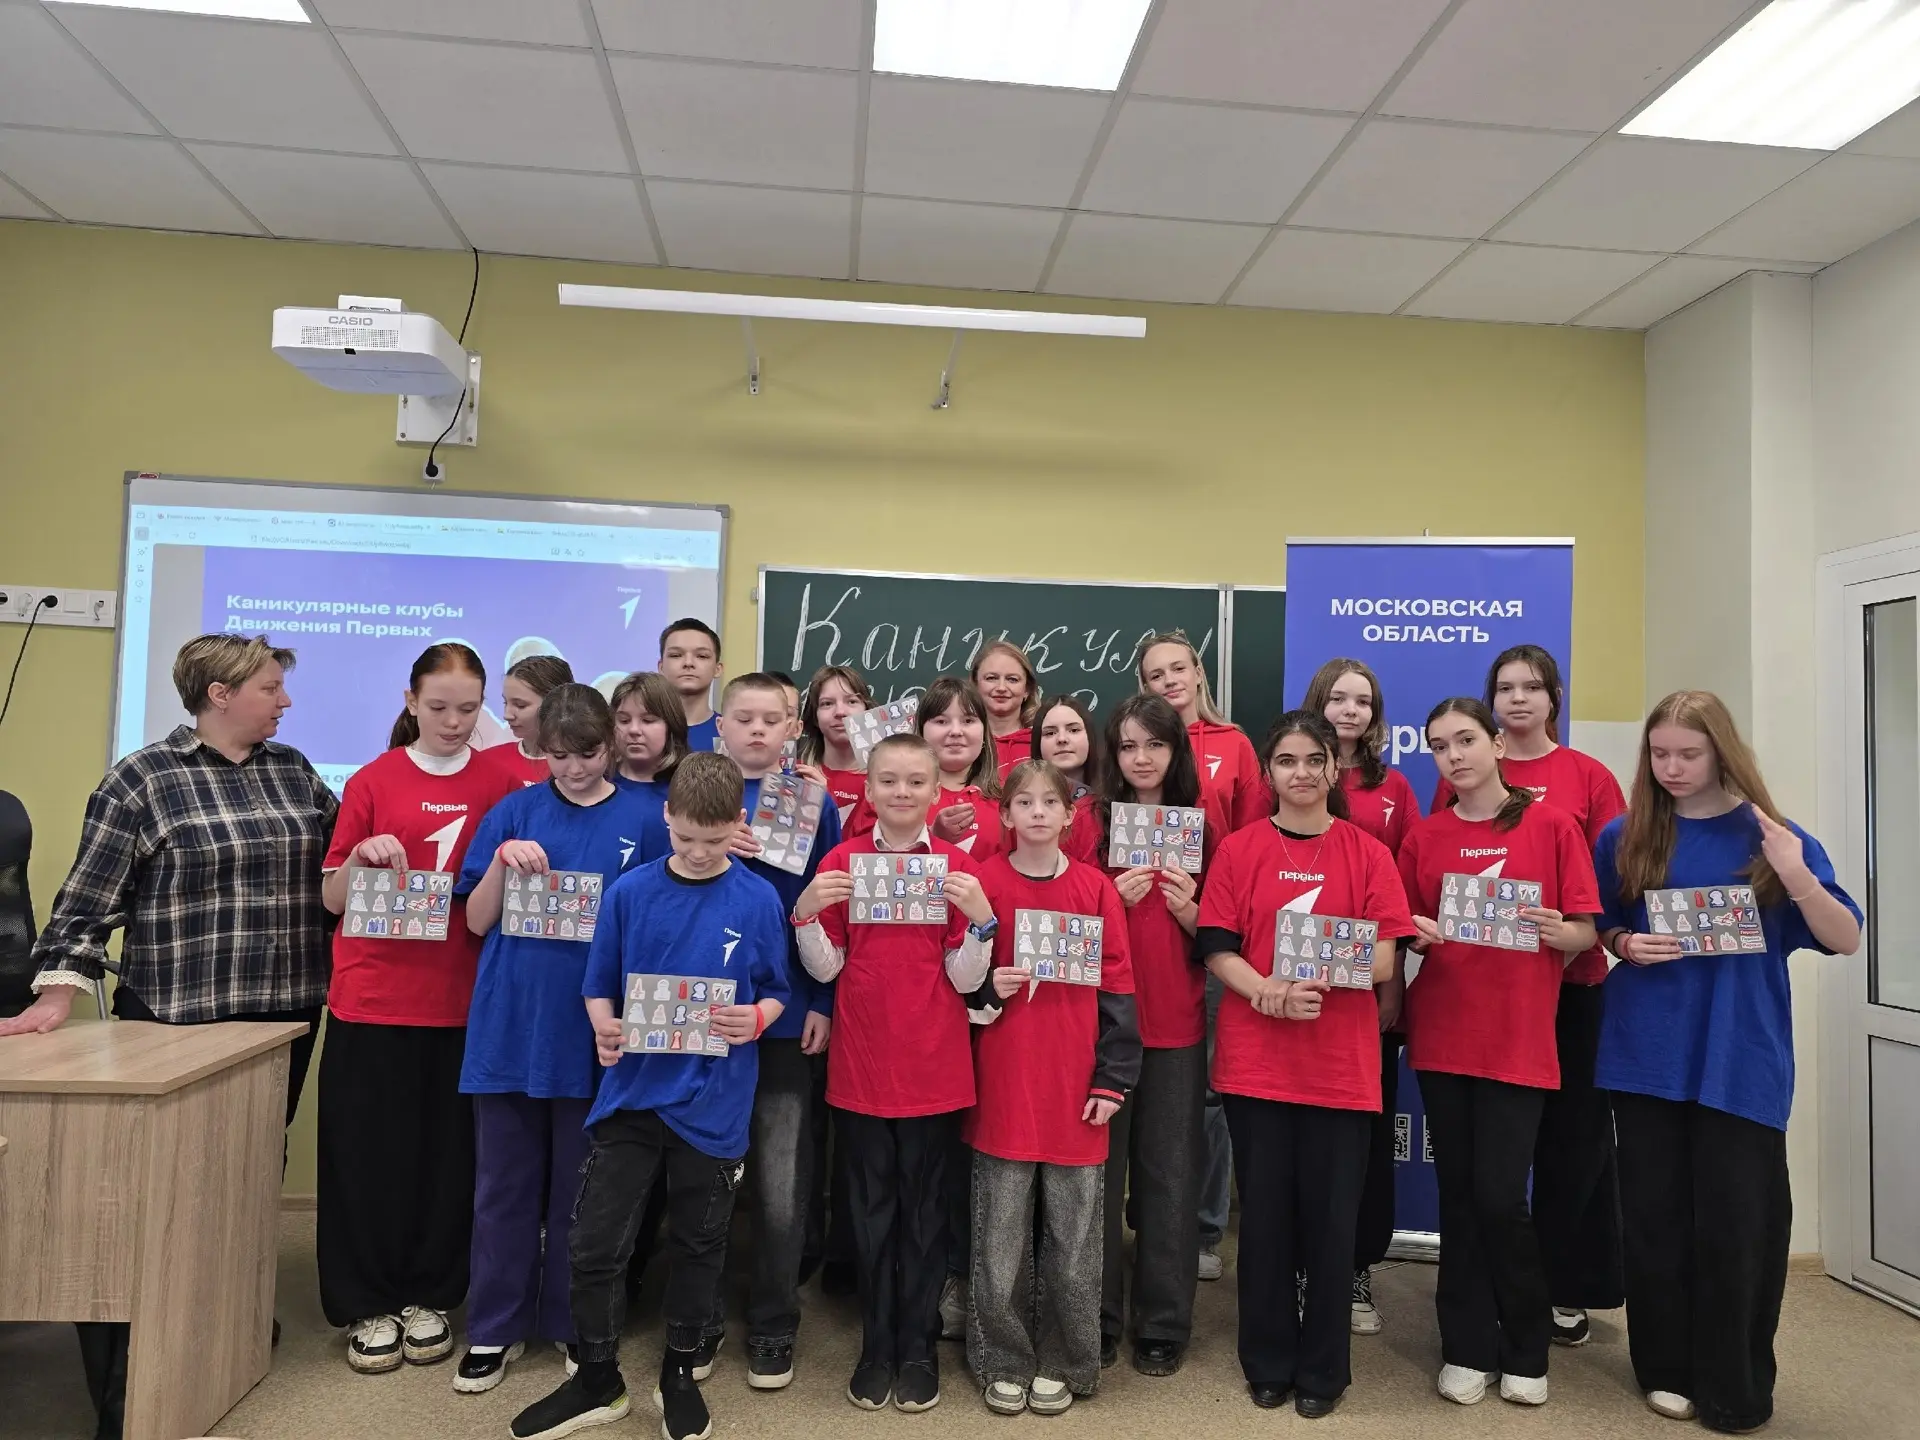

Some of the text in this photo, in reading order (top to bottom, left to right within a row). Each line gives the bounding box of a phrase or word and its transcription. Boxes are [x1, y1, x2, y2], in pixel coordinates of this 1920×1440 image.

[328, 315, 373, 326] CASIO
[226, 594, 463, 619] Каникулярные клубы
[1330, 598, 1523, 617] МОСКОВСКАЯ
[224, 615, 432, 639] Движения Первых
[1362, 624, 1489, 643] ОБЛАСТЬ
[421, 801, 468, 815] Первые
[1460, 846, 1509, 859] Первые
[1278, 871, 1325, 883] Первые
